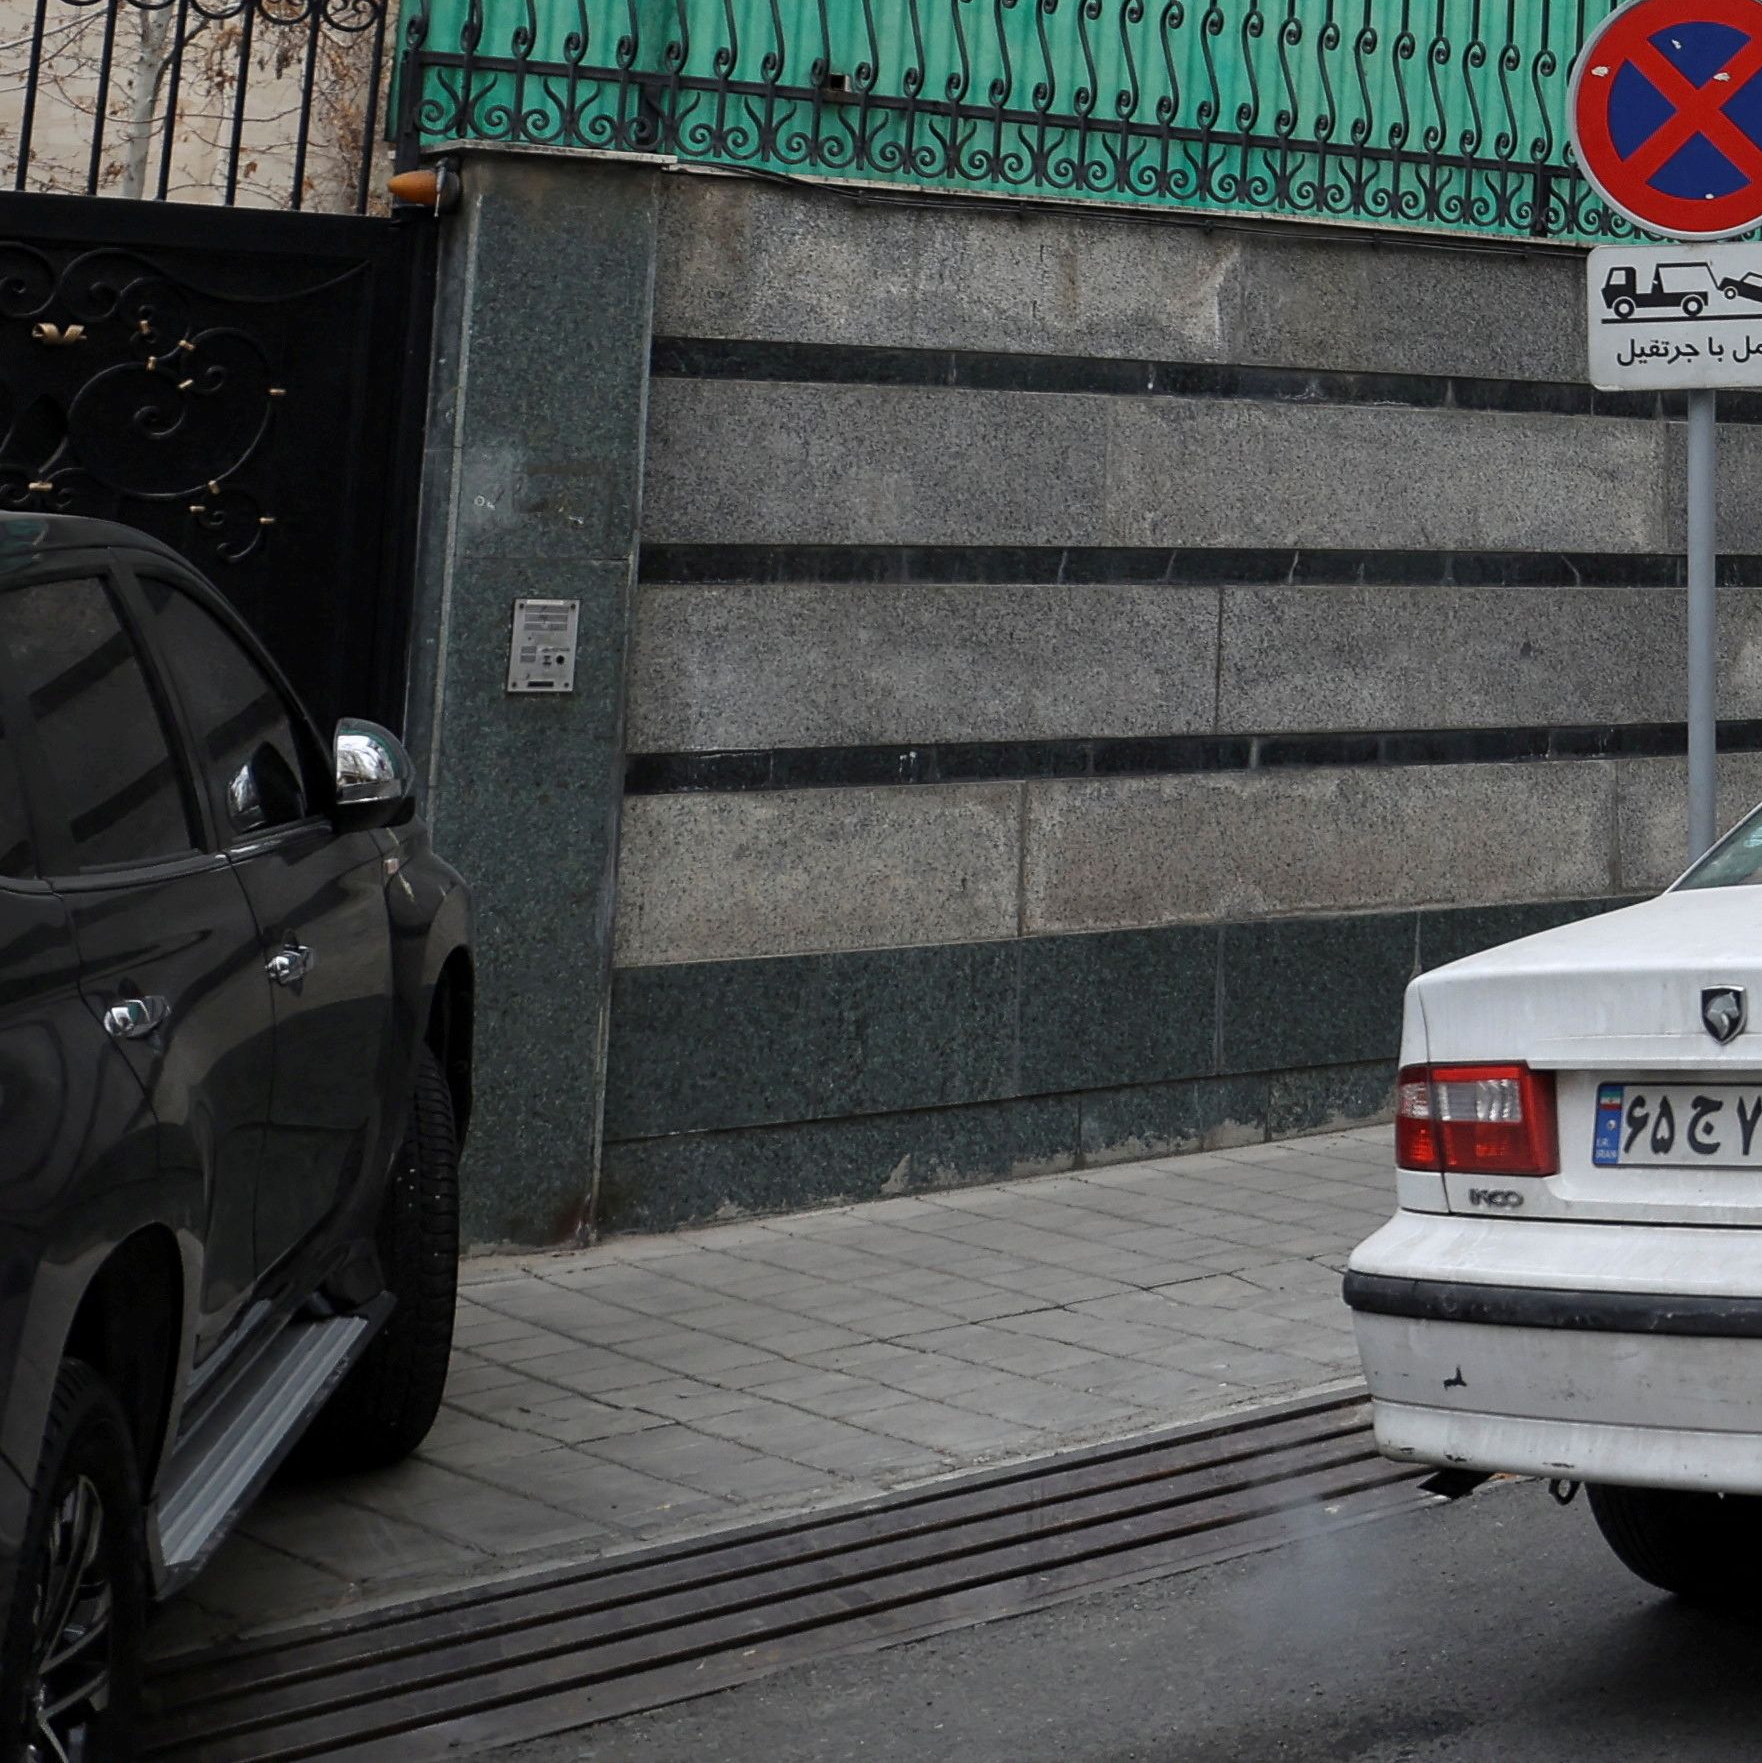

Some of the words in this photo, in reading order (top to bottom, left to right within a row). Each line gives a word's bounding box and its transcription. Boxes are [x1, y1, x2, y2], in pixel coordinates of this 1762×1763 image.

[1708, 336, 1724, 363] با
[1623, 1094, 1676, 1155] ۶۵
[1687, 1094, 1724, 1155] ج
